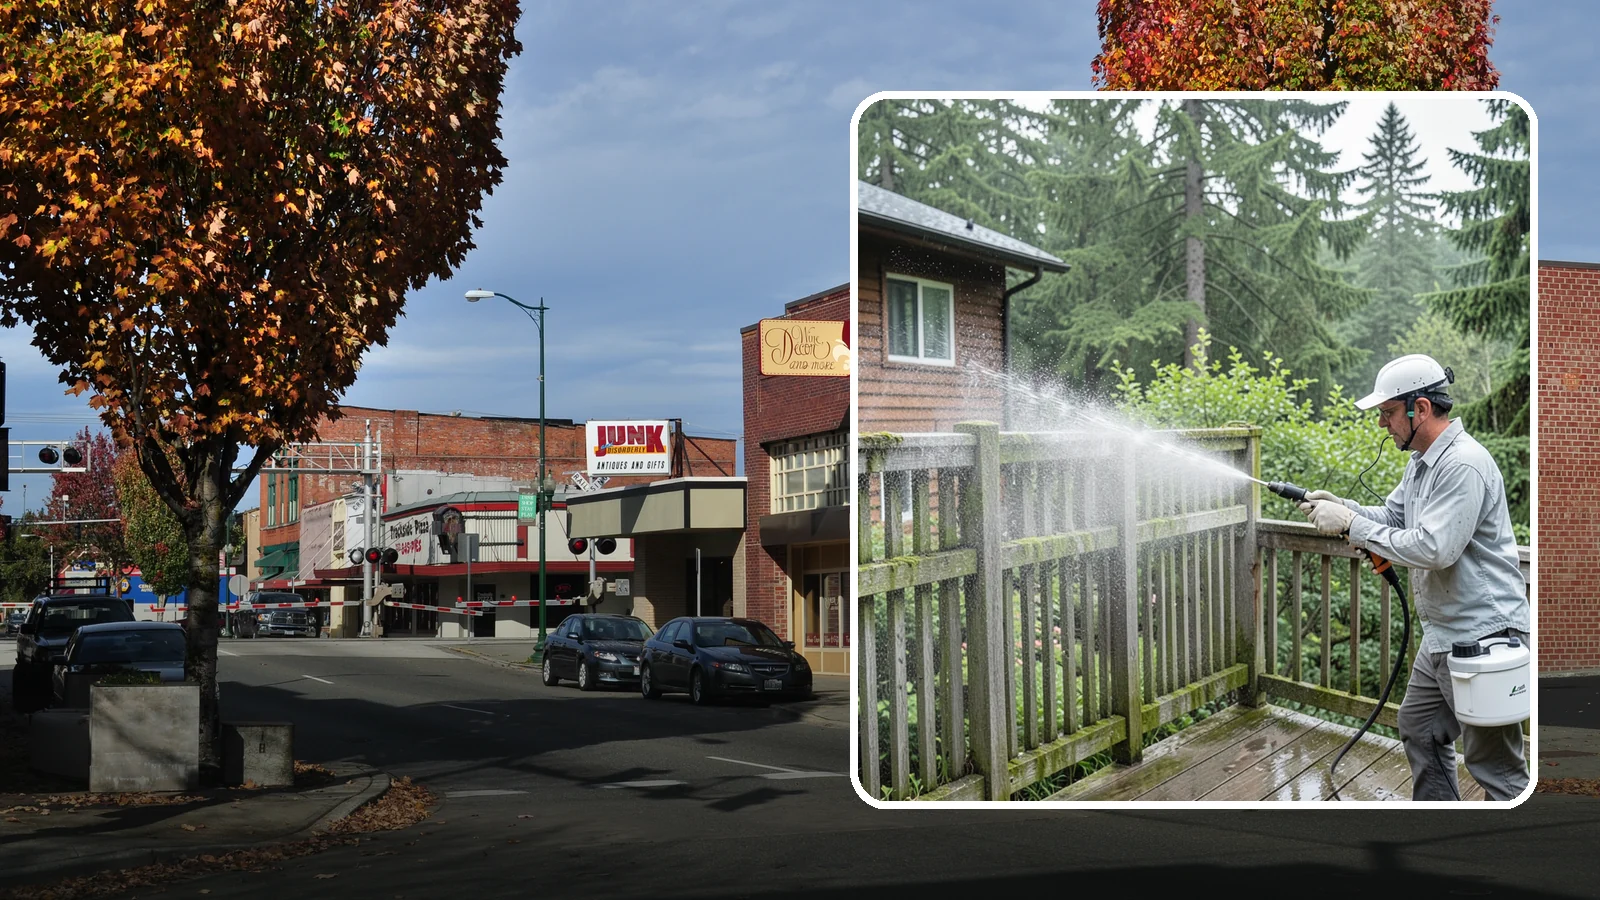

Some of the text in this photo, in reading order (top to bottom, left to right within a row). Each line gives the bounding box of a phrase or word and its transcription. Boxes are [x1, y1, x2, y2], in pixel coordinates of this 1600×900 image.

[595, 425, 665, 457] JUNK
[607, 446, 646, 454] DISORDERLY
[596, 460, 666, 470] ANTIQUES AND GIFTS
[390, 519, 429, 539] Trackside Pizza
